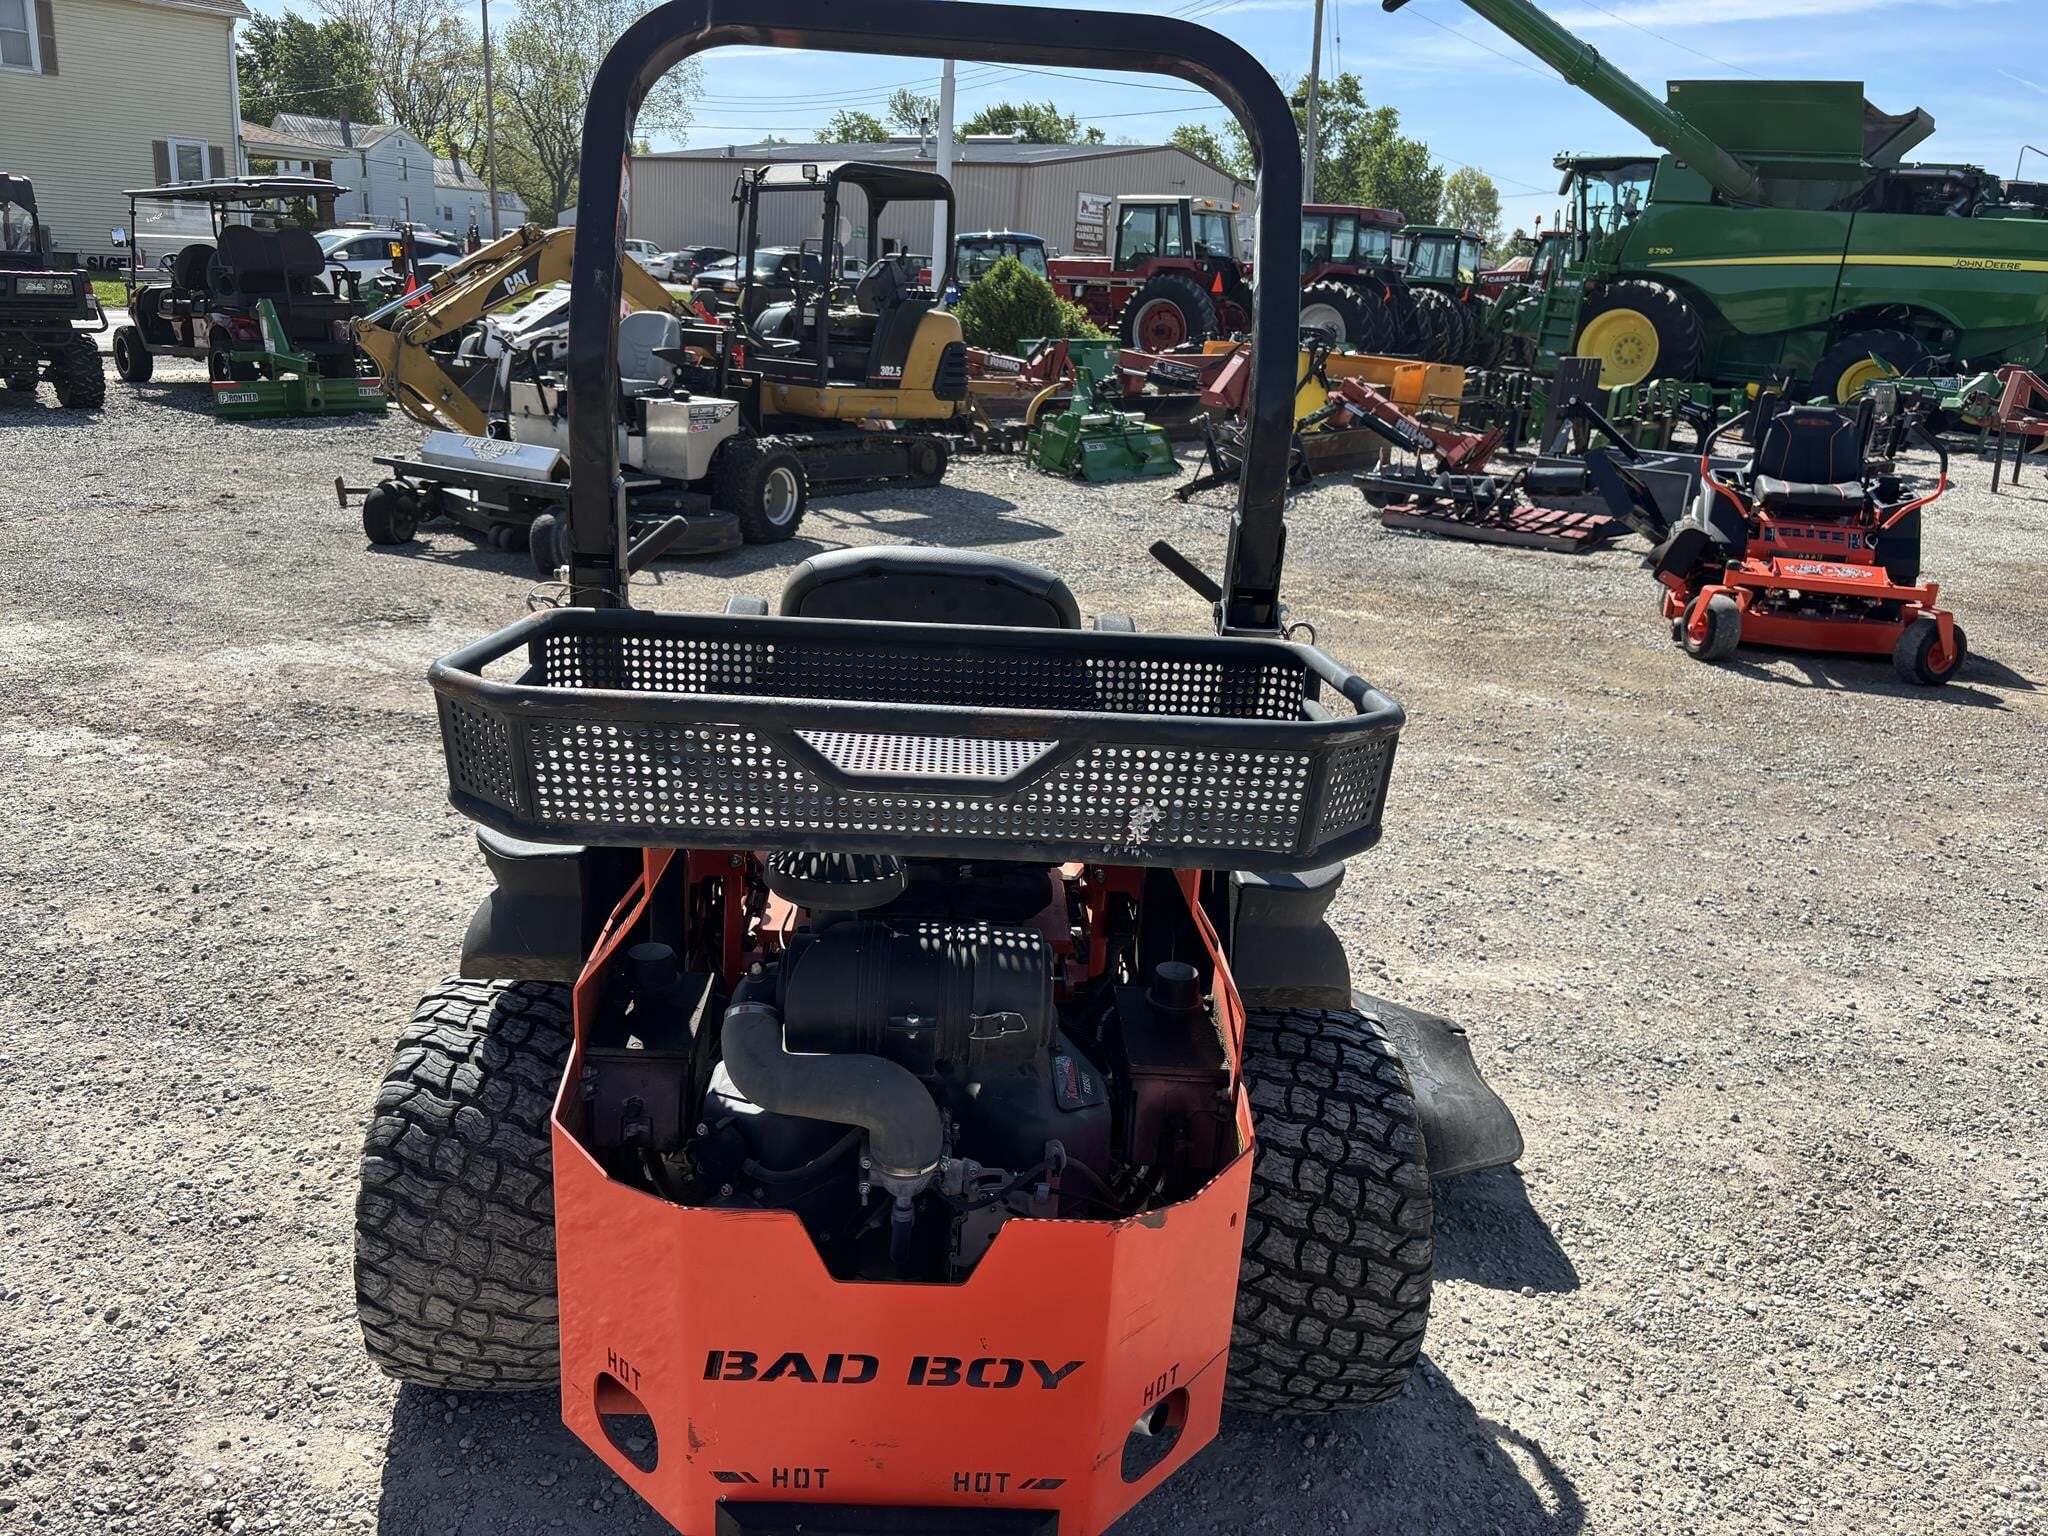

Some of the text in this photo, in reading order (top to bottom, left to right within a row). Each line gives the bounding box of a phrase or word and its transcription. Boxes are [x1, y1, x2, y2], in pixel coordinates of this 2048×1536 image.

[1953, 258, 2022, 270] JOHN DEERE
[503, 268, 532, 296] CAT
[880, 365, 902, 377] 302.5
[989, 355, 1021, 372] RHINO
[218, 391, 259, 405] FRONTIER
[607, 1347, 642, 1391] HOT
[702, 1350, 1086, 1390] BAD BOY
[1143, 1362, 1180, 1406] HOT
[772, 1468, 830, 1489] HOT
[953, 1471, 1011, 1493] HOT
